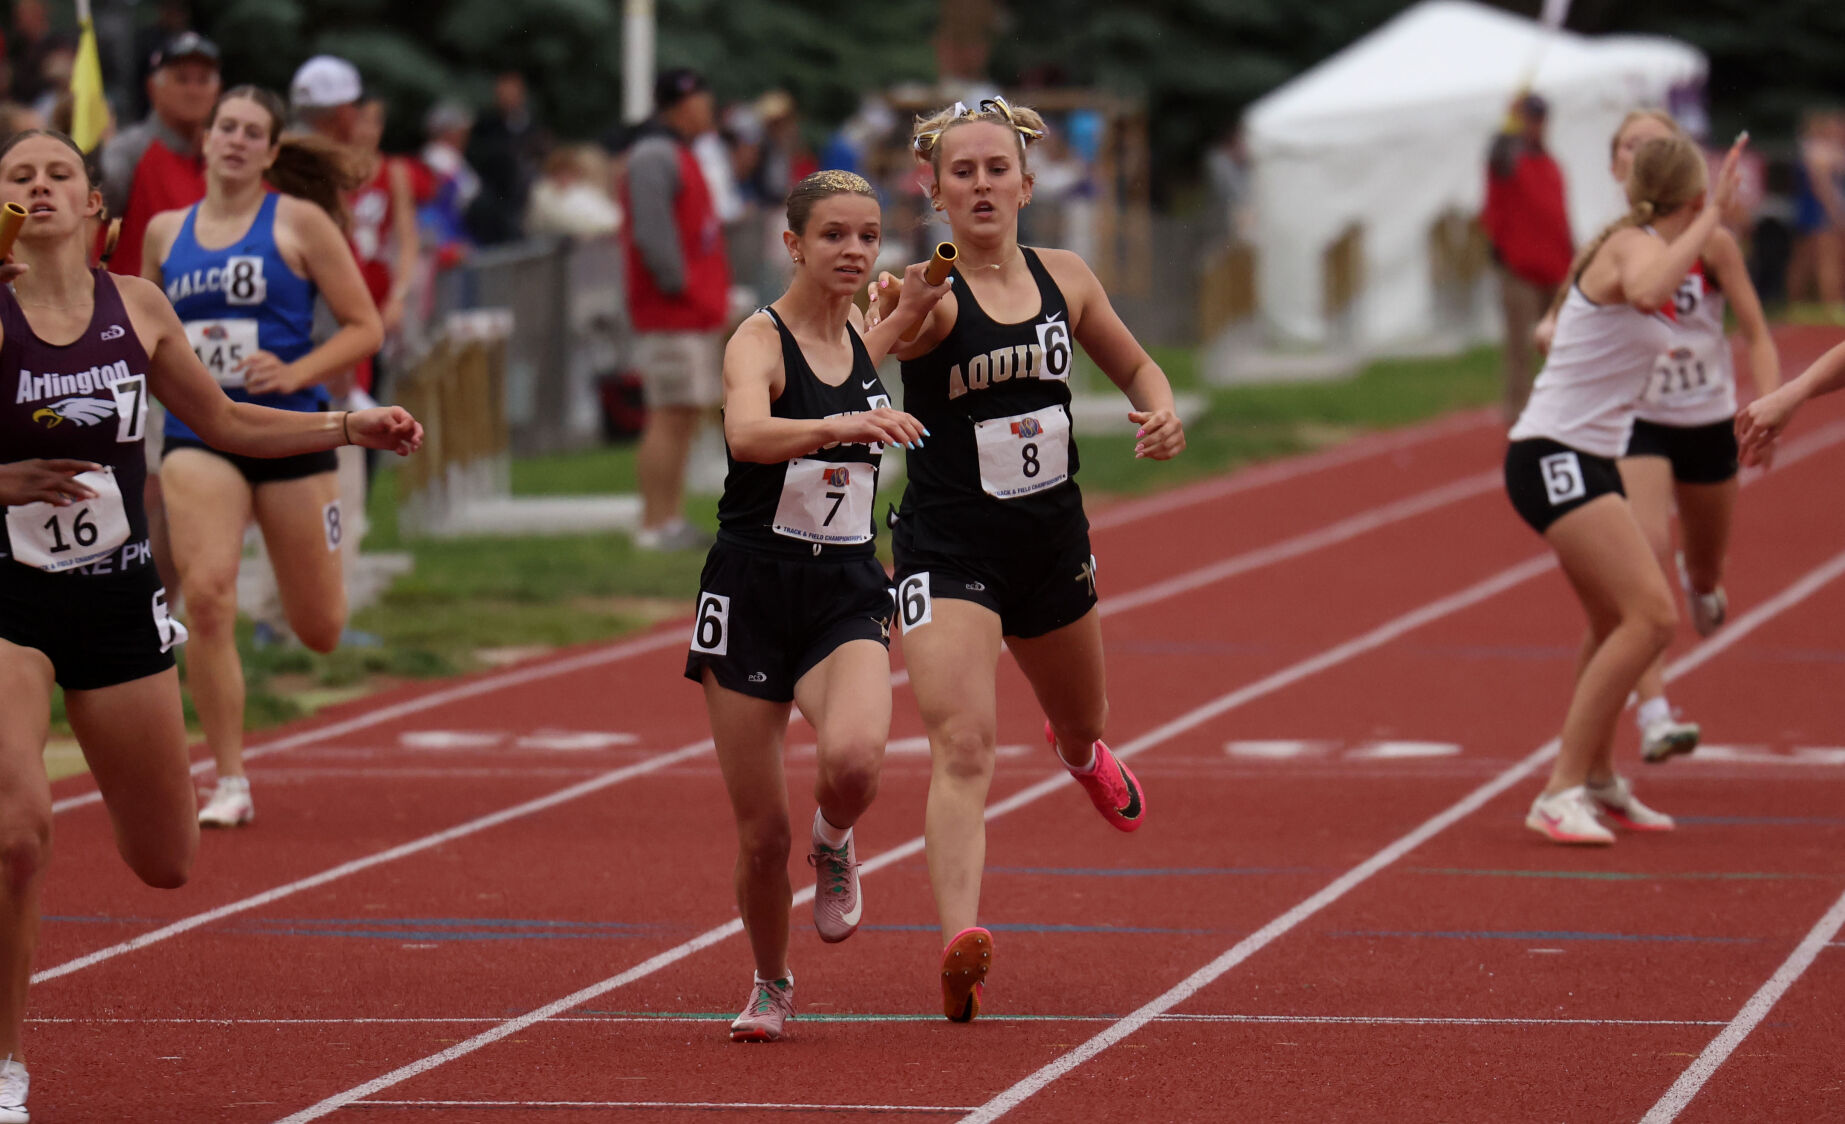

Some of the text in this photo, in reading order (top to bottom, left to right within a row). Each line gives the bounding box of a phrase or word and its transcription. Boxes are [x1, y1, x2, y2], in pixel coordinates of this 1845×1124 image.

[232, 261, 255, 299] 8
[1675, 280, 1695, 315] 5
[1044, 325, 1068, 375] 6
[16, 360, 130, 404] Arlington
[1656, 361, 1707, 394] 211
[117, 380, 141, 437] 7
[1022, 442, 1040, 478] 8
[1550, 459, 1574, 496] 5
[328, 506, 341, 544] 8
[822, 492, 845, 527] 7
[44, 508, 98, 553] 16
[784, 526, 801, 536] TRACK
[809, 532, 823, 540] FIELD
[902, 578, 925, 626] 6
[697, 597, 722, 649] 6
